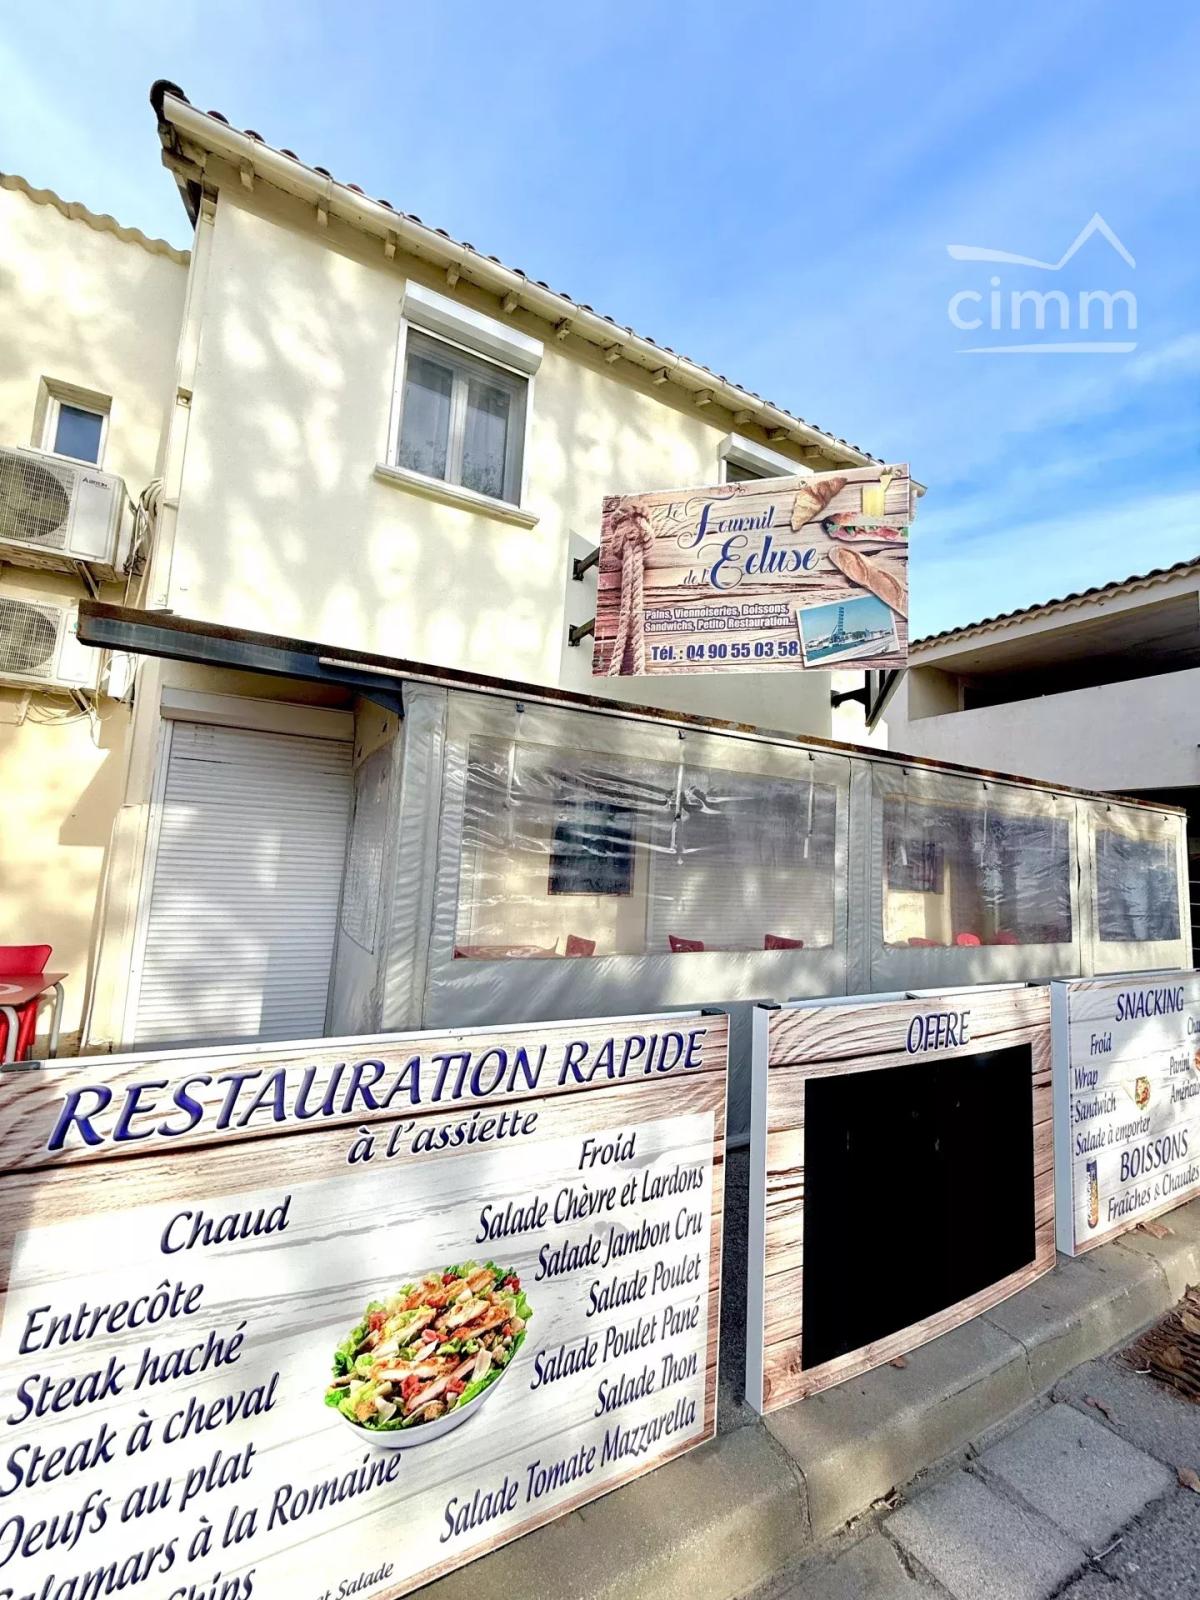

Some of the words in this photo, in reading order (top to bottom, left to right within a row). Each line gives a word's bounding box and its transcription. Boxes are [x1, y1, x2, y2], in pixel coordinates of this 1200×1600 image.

[677, 492, 775, 549] Fournil
[684, 569, 699, 585] de
[644, 619, 696, 633] Sandwichs,
[698, 618, 725, 631] Petite
[645, 609, 672, 621] Pains,
[674, 606, 740, 620] Viennoiseries,
[742, 603, 790, 616] Boissons,
[686, 644, 705, 660] 04
[708, 643, 728, 659] 90
[731, 642, 750, 658] 55
[754, 641, 776, 657] 03
[778, 640, 799, 656] 58
[1115, 986, 1184, 1022] SNACKING
[906, 1010, 971, 1054] OFFRE
[1090, 1032, 1112, 1056] Froid
[47, 1043, 548, 1151] RESTAURATION
[557, 1029, 707, 1086] RAPIDE
[1074, 1067, 1098, 1092] Wrap
[1169, 1051, 1191, 1076] Panini
[1074, 1091, 1117, 1123] Sandwich
[347, 1125, 375, 1164] à
[385, 1110, 540, 1159] l'assiette
[578, 1132, 636, 1171] Froid
[1075, 1126, 1106, 1156] Salade
[1107, 1122, 1114, 1147] à
[1115, 1116, 1151, 1144] emporter
[1120, 1129, 1189, 1183] BOISSONS
[475, 1196, 549, 1244] Salade
[553, 1184, 616, 1226] Chèvre
[620, 1180, 638, 1208] et
[641, 1165, 704, 1202] Lardons
[1107, 1183, 1151, 1222] Fraîches
[1162, 1165, 1200, 1197] Chaudes
[160, 1195, 292, 1254] Chaud
[534, 1238, 602, 1281] Salade
[603, 1220, 671, 1267] Jambon
[675, 1207, 703, 1237] Cru
[586, 1272, 647, 1318] Salade
[652, 1252, 703, 1295] Poulet
[17, 1278, 205, 1355] Entrecôte
[530, 1336, 598, 1390] Salade
[602, 1320, 658, 1362] Poulet
[661, 1295, 700, 1340] Pané
[6, 1355, 127, 1425] Steak
[134, 1320, 248, 1391] haché
[594, 1367, 655, 1418] Salade
[661, 1351, 698, 1386] Thon
[0, 1421, 118, 1498] Steak
[125, 1409, 153, 1457] à
[162, 1371, 281, 1445] cheval
[439, 1476, 520, 1544] Salade
[525, 1443, 596, 1503] Tomate
[600, 1400, 697, 1468] Mazzarella
[0, 1489, 112, 1568] Oeufs
[120, 1475, 173, 1524] au
[178, 1441, 258, 1513] plat
[187, 1516, 212, 1563] à
[222, 1499, 258, 1549] la
[266, 1451, 402, 1532] Romaine
[335, 1561, 395, 1600] Salade
